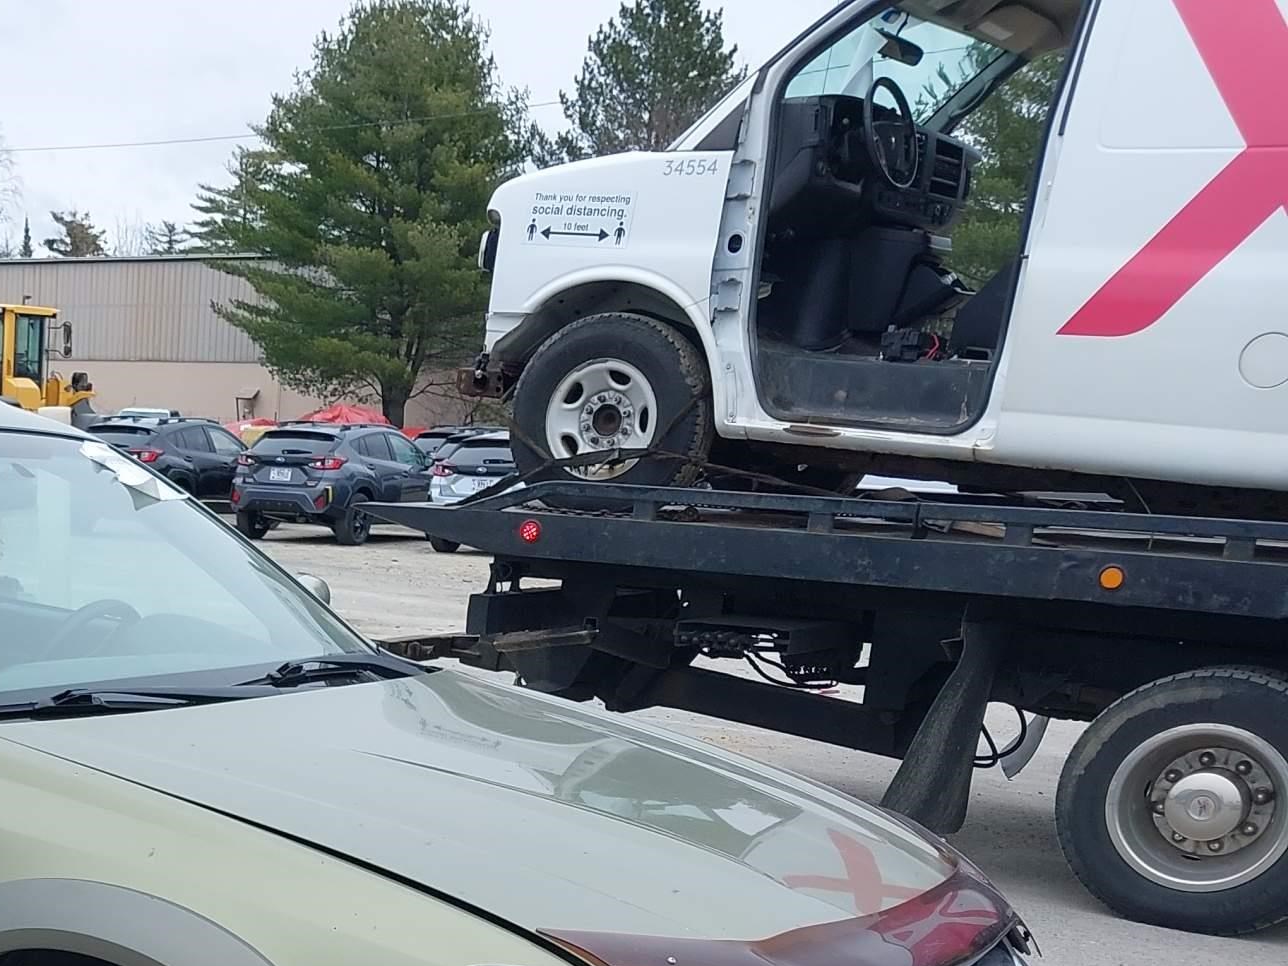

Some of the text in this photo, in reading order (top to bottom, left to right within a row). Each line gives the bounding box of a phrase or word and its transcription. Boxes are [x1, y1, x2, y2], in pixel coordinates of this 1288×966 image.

[663, 159, 718, 176] 34554
[535, 192, 631, 206] Thank you for respecting
[532, 204, 627, 220] social distancing.
[563, 222, 589, 232] 10 feet
